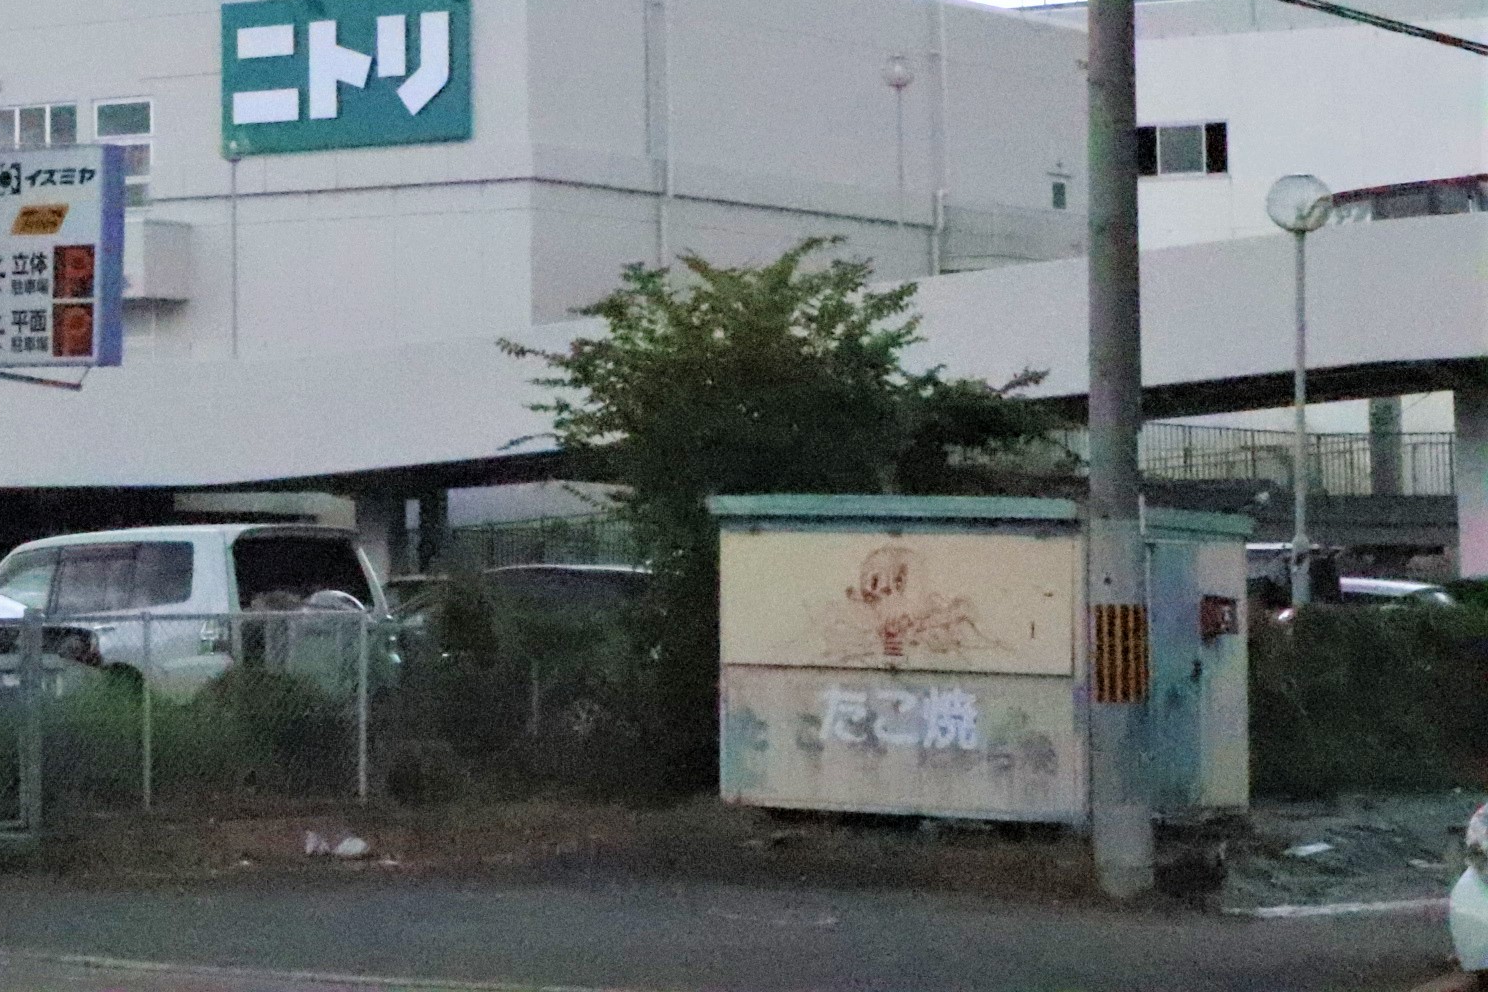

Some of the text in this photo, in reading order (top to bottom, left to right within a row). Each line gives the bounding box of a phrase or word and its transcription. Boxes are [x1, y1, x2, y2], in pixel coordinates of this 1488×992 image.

[232, 11, 449, 125] ニトリ
[24, 167, 95, 188] イズミヤ
[12, 252, 47, 275] 立体
[12, 309, 47, 333] 平面
[819, 686, 980, 751] たこ焼
